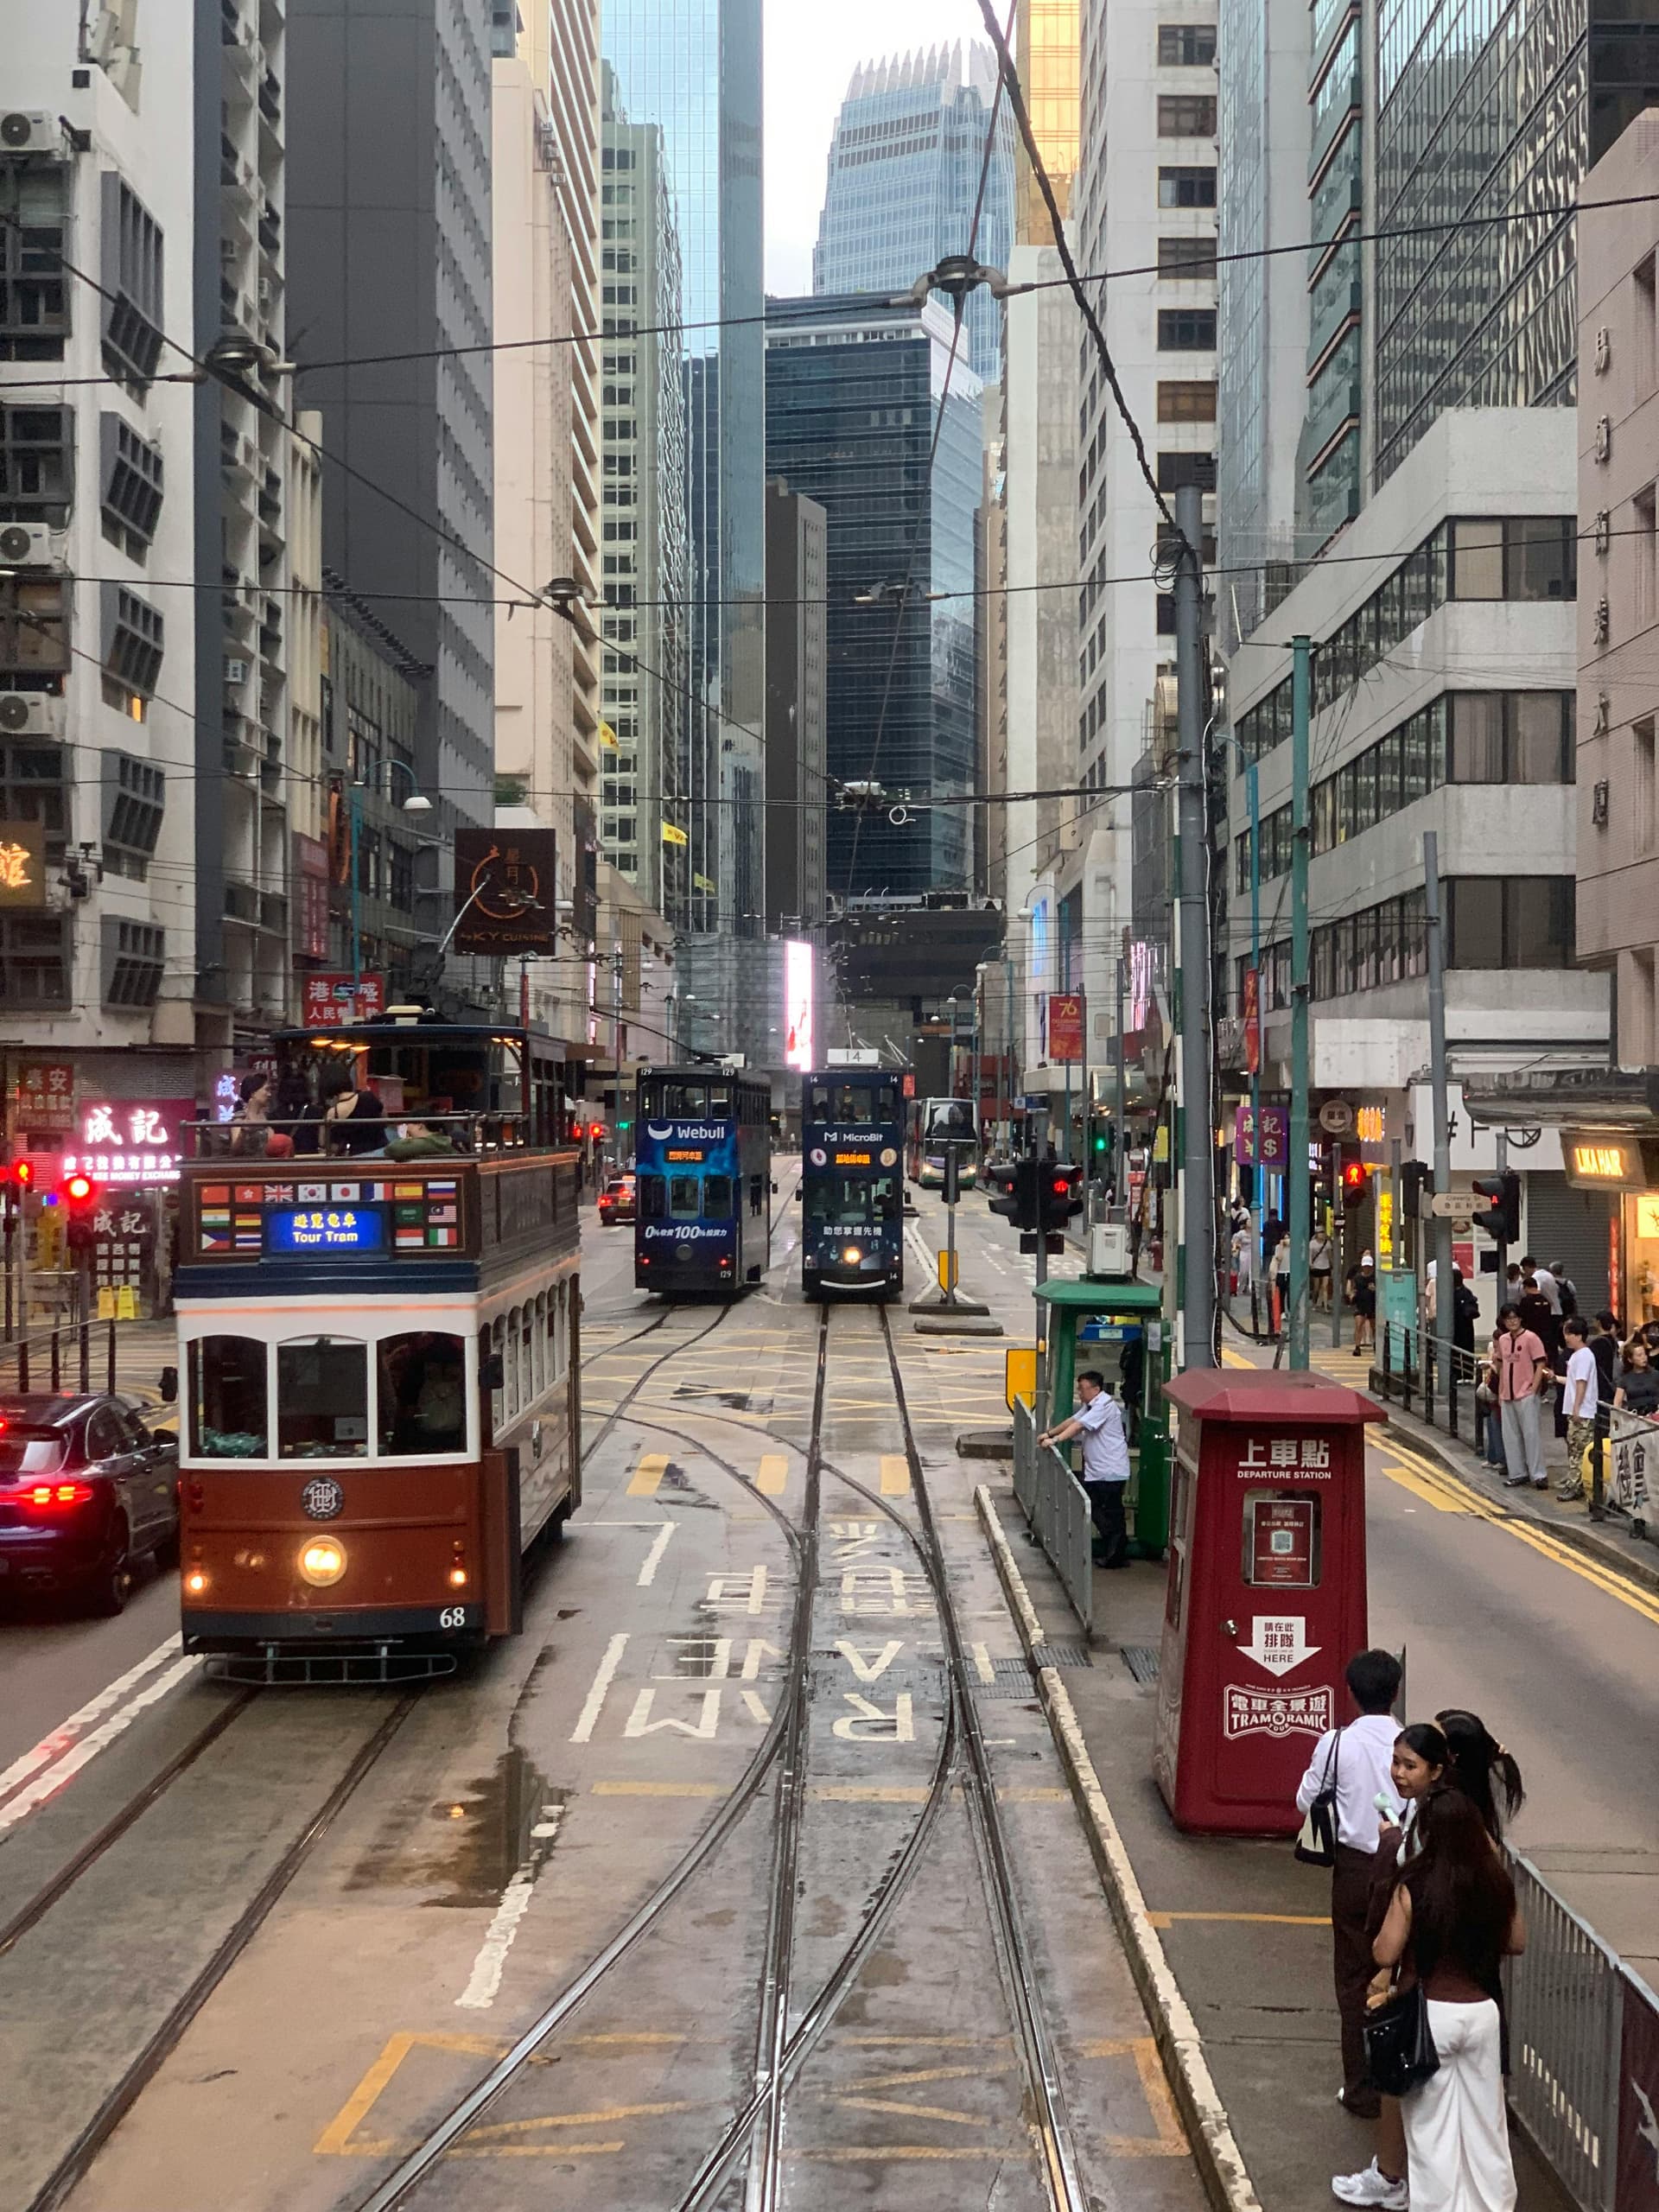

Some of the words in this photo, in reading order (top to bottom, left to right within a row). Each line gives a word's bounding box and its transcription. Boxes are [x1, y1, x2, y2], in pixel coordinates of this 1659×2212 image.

[309, 982, 329, 1002] 港
[1058, 999, 1077, 1018] 76
[846, 1050, 862, 1063] 14
[640, 1067, 652, 1076] 129
[721, 1067, 734, 1077] 129
[890, 1075, 899, 1084] 14
[85, 1106, 169, 1145] 成記
[677, 1126, 725, 1139] Webull
[842, 1133, 884, 1141] MicroBit
[1263, 1138, 1277, 1158] $
[110, 1171, 142, 1181] MONEY
[93, 1209, 146, 1237] 成記
[292, 1231, 322, 1243] Tour
[325, 1231, 358, 1243] Tram
[720, 1270, 732, 1279] 129
[1238, 1439, 1330, 1468] 上車點
[1294, 1471, 1332, 1479] STATION
[440, 1607, 465, 1628] 68
[1264, 1622, 1294, 1632] 請在此
[1264, 1633, 1294, 1648] 排隊
[1263, 1654, 1294, 1662] HERE
[1231, 1711, 1327, 1732] TRAMORAMIC
[1268, 1723, 1289, 1732] TOUR
